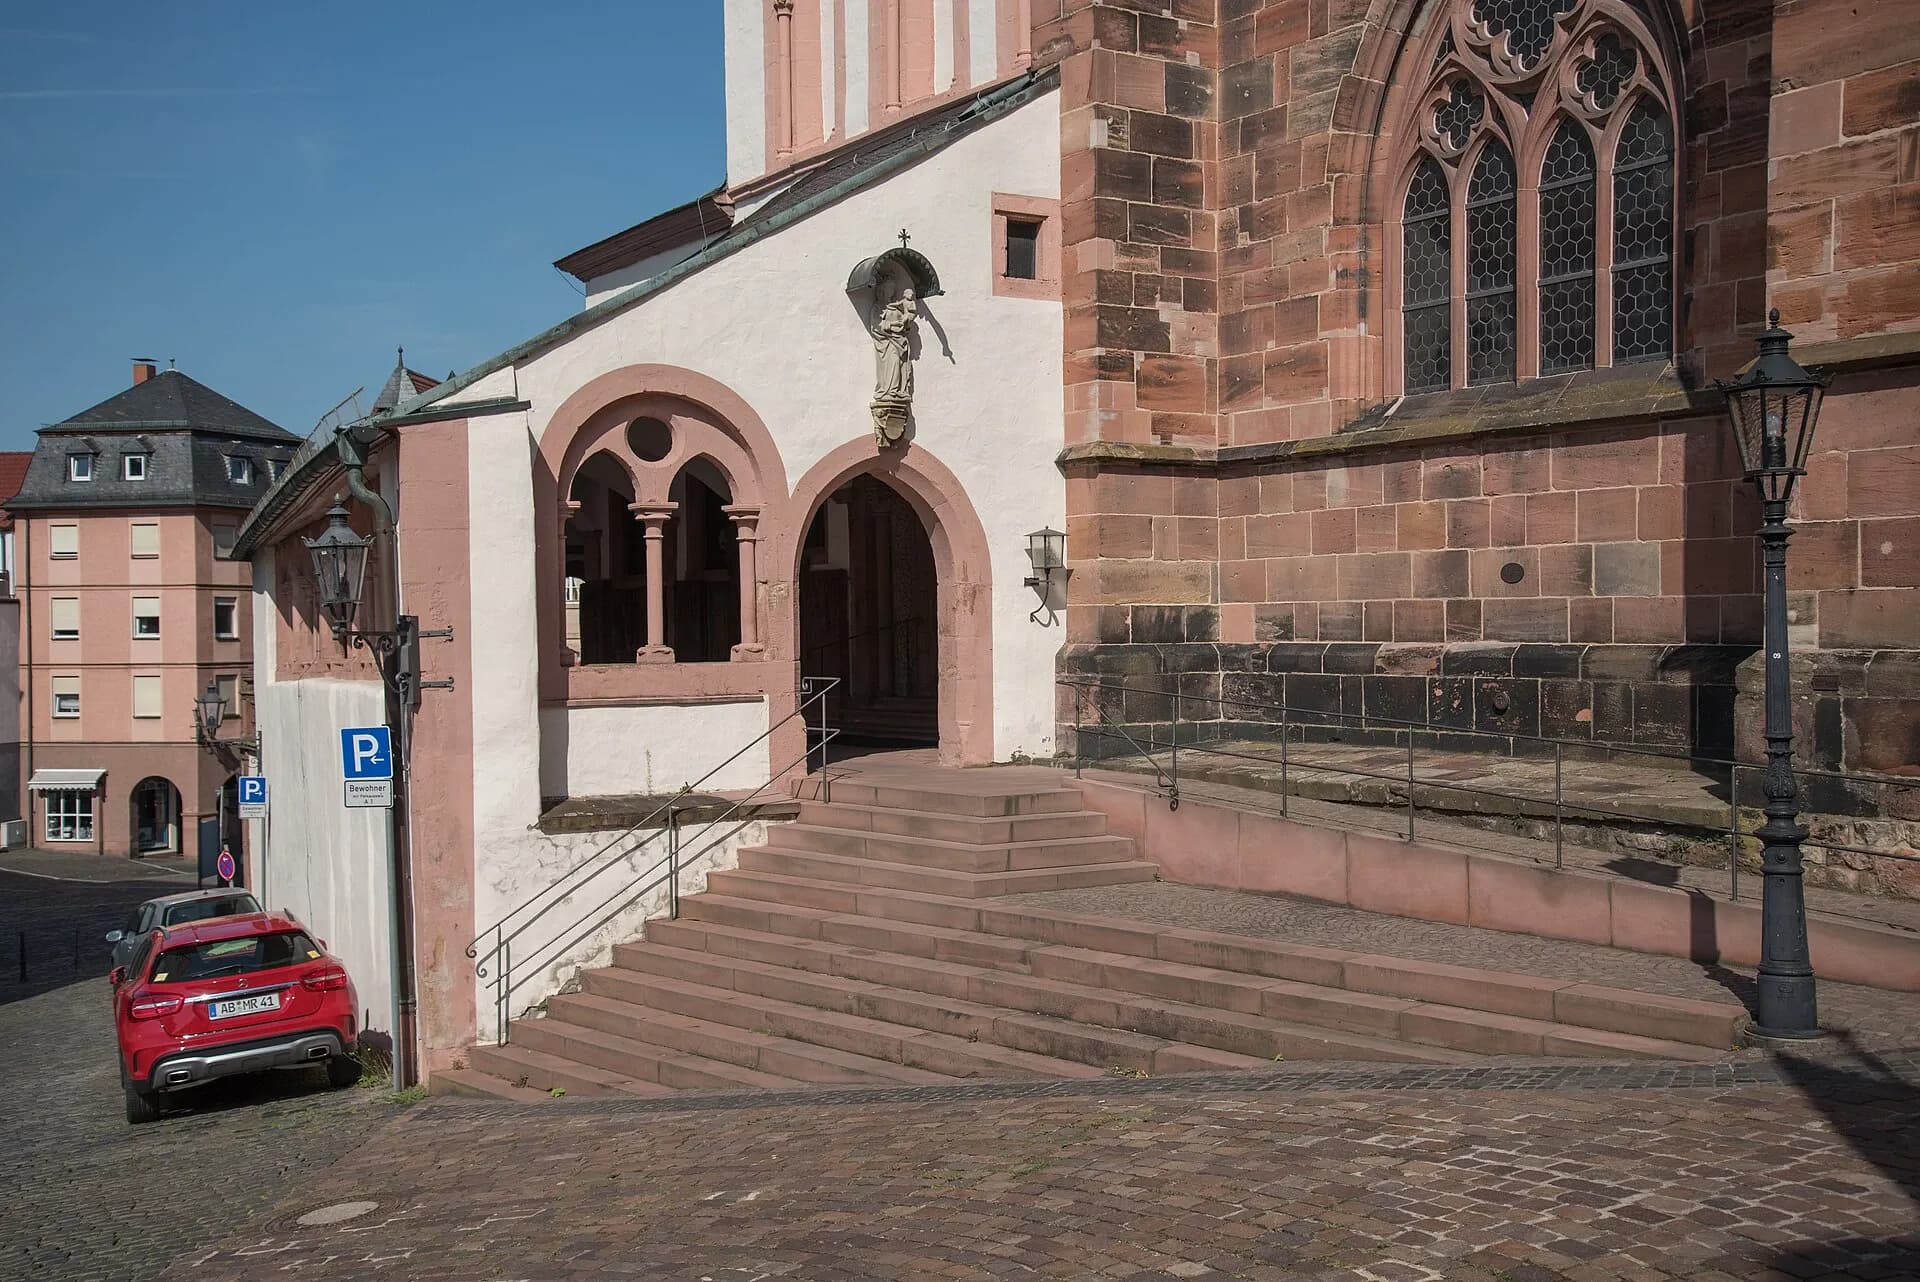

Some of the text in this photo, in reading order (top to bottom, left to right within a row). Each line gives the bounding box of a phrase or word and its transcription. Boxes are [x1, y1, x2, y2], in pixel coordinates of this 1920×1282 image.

[352, 734, 379, 772] P
[246, 780, 260, 800] P
[350, 784, 386, 792] Bewohner
[221, 995, 274, 1014] AB MR 41
